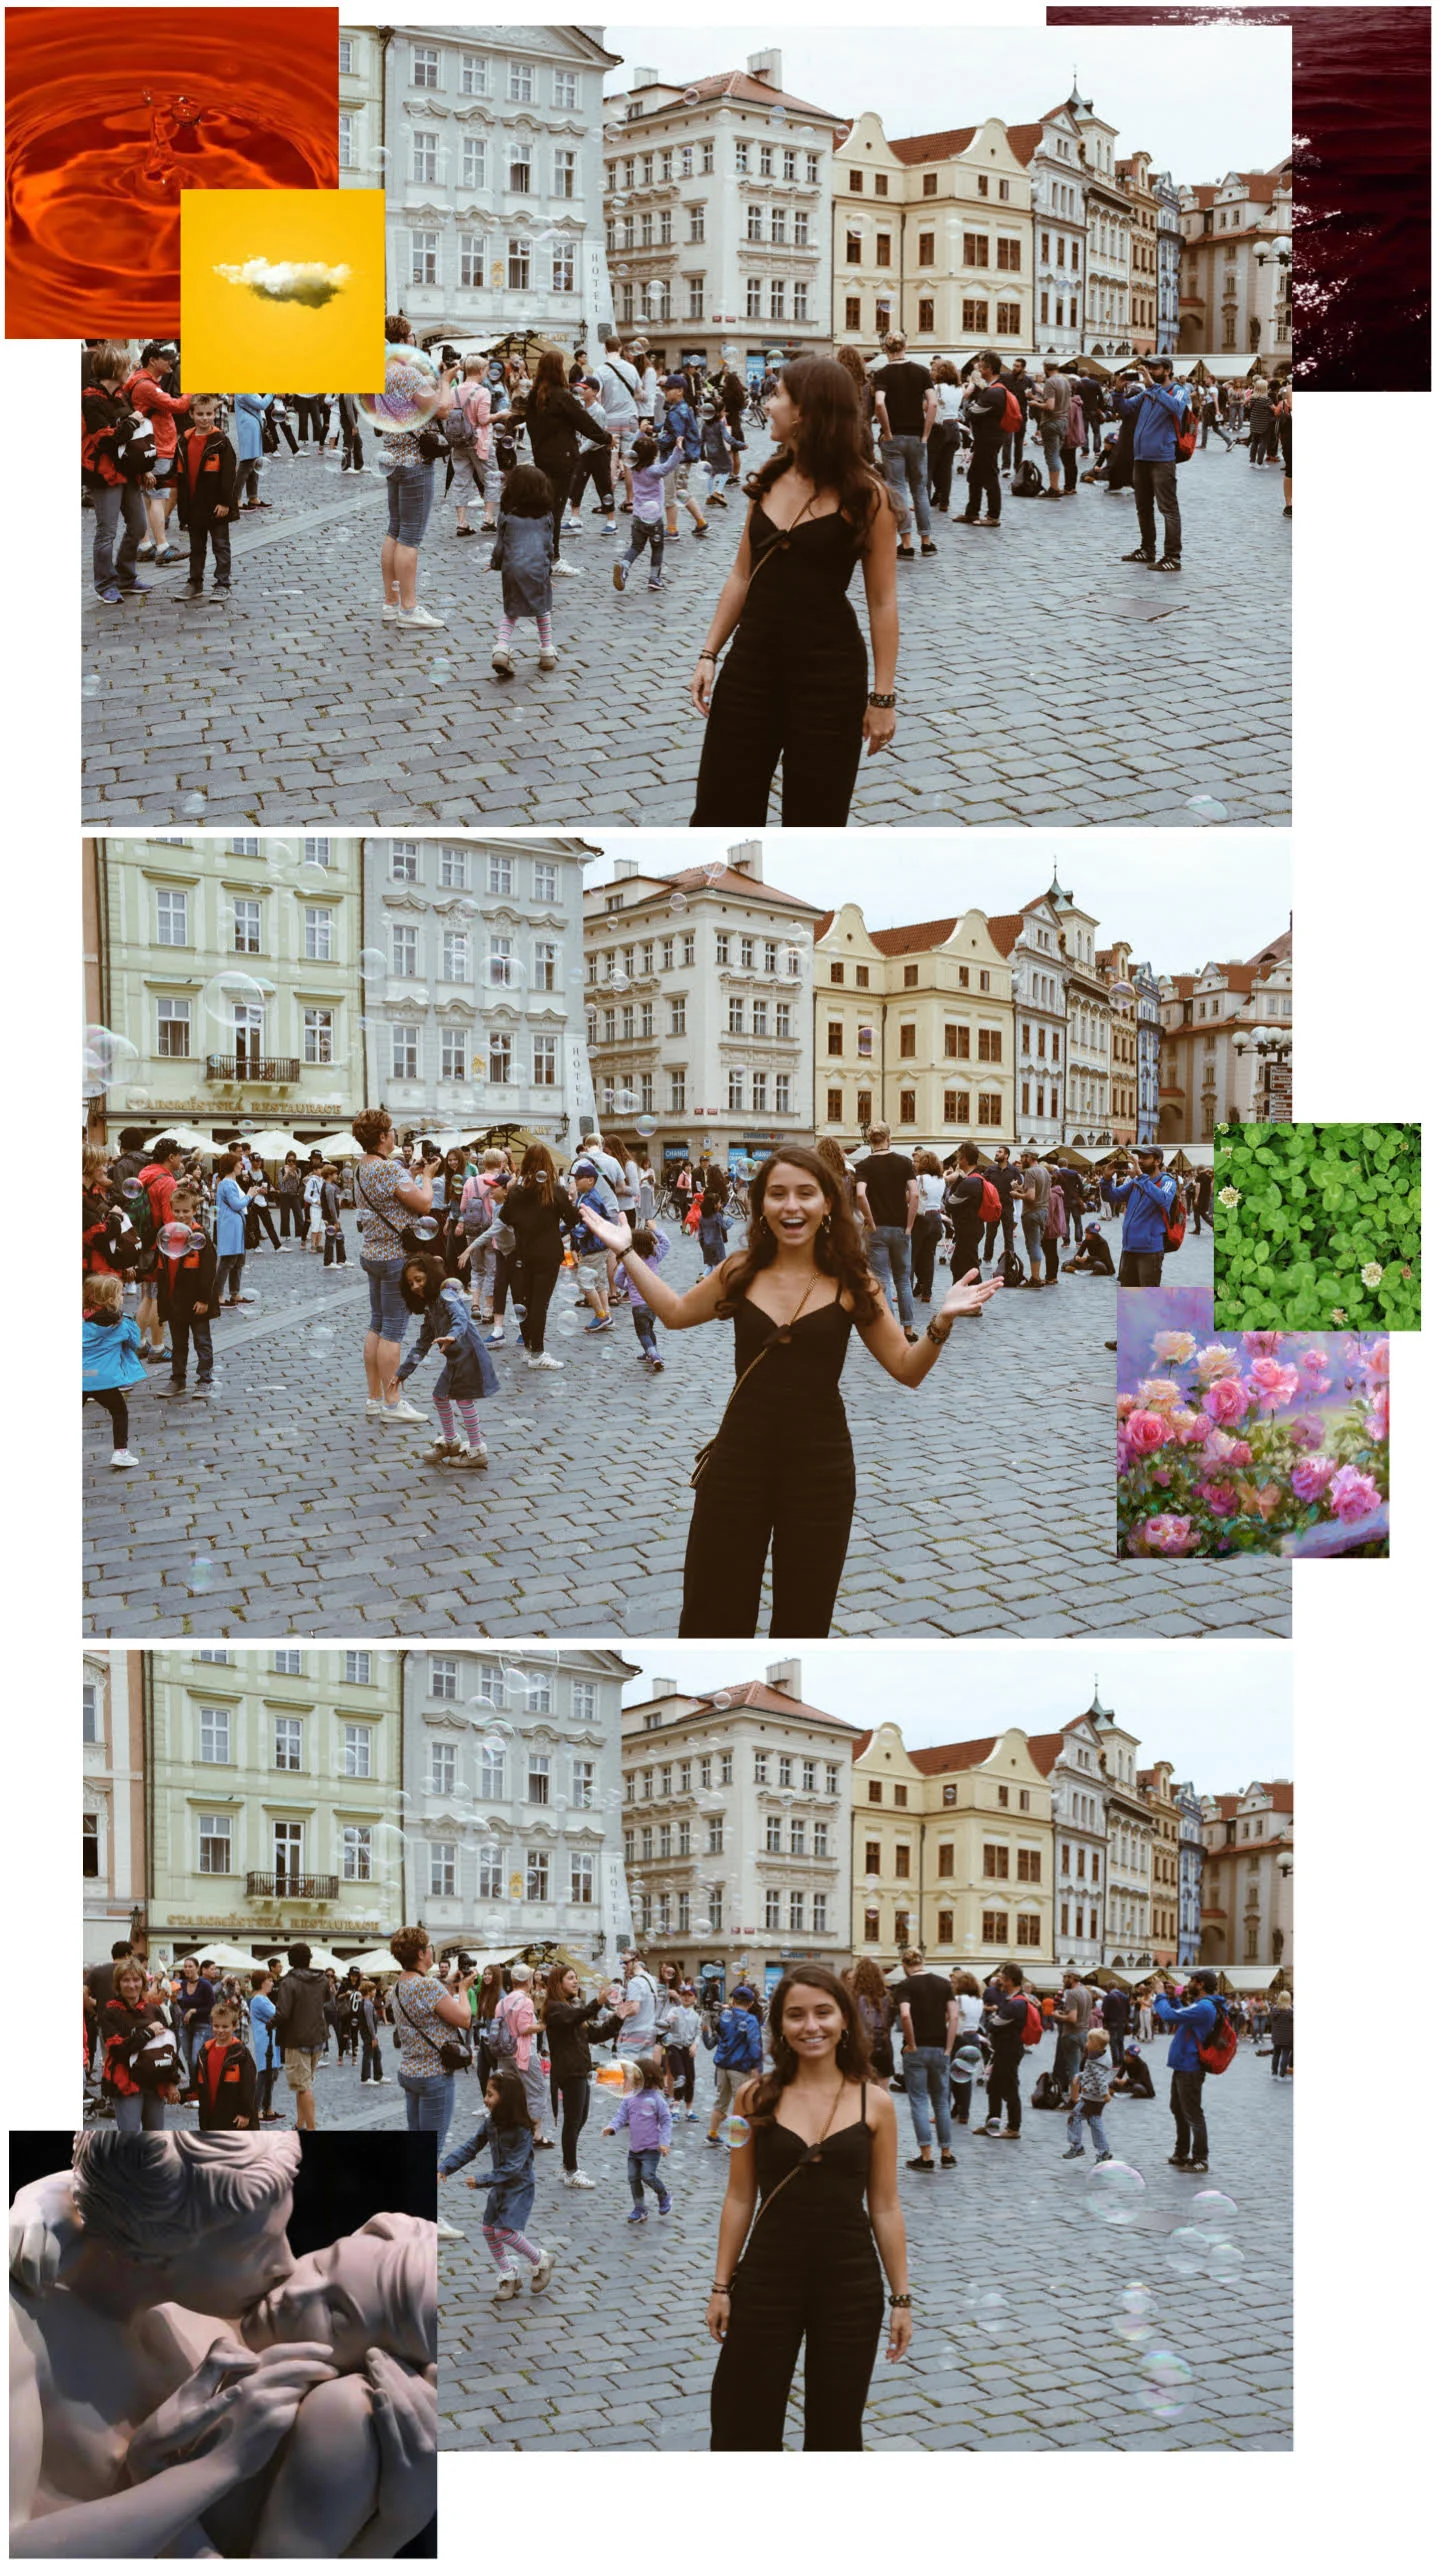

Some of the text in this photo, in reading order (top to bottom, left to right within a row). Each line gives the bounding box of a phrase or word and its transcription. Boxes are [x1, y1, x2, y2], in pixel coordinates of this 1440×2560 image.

[591, 253, 600, 313] HOTEL
[572, 1047, 583, 1107] HOTEL
[251, 1102, 342, 1114] RESTAURACE
[290, 1917, 378, 1931] RESTAURACE
[610, 1866, 620, 1925] HOTEL
